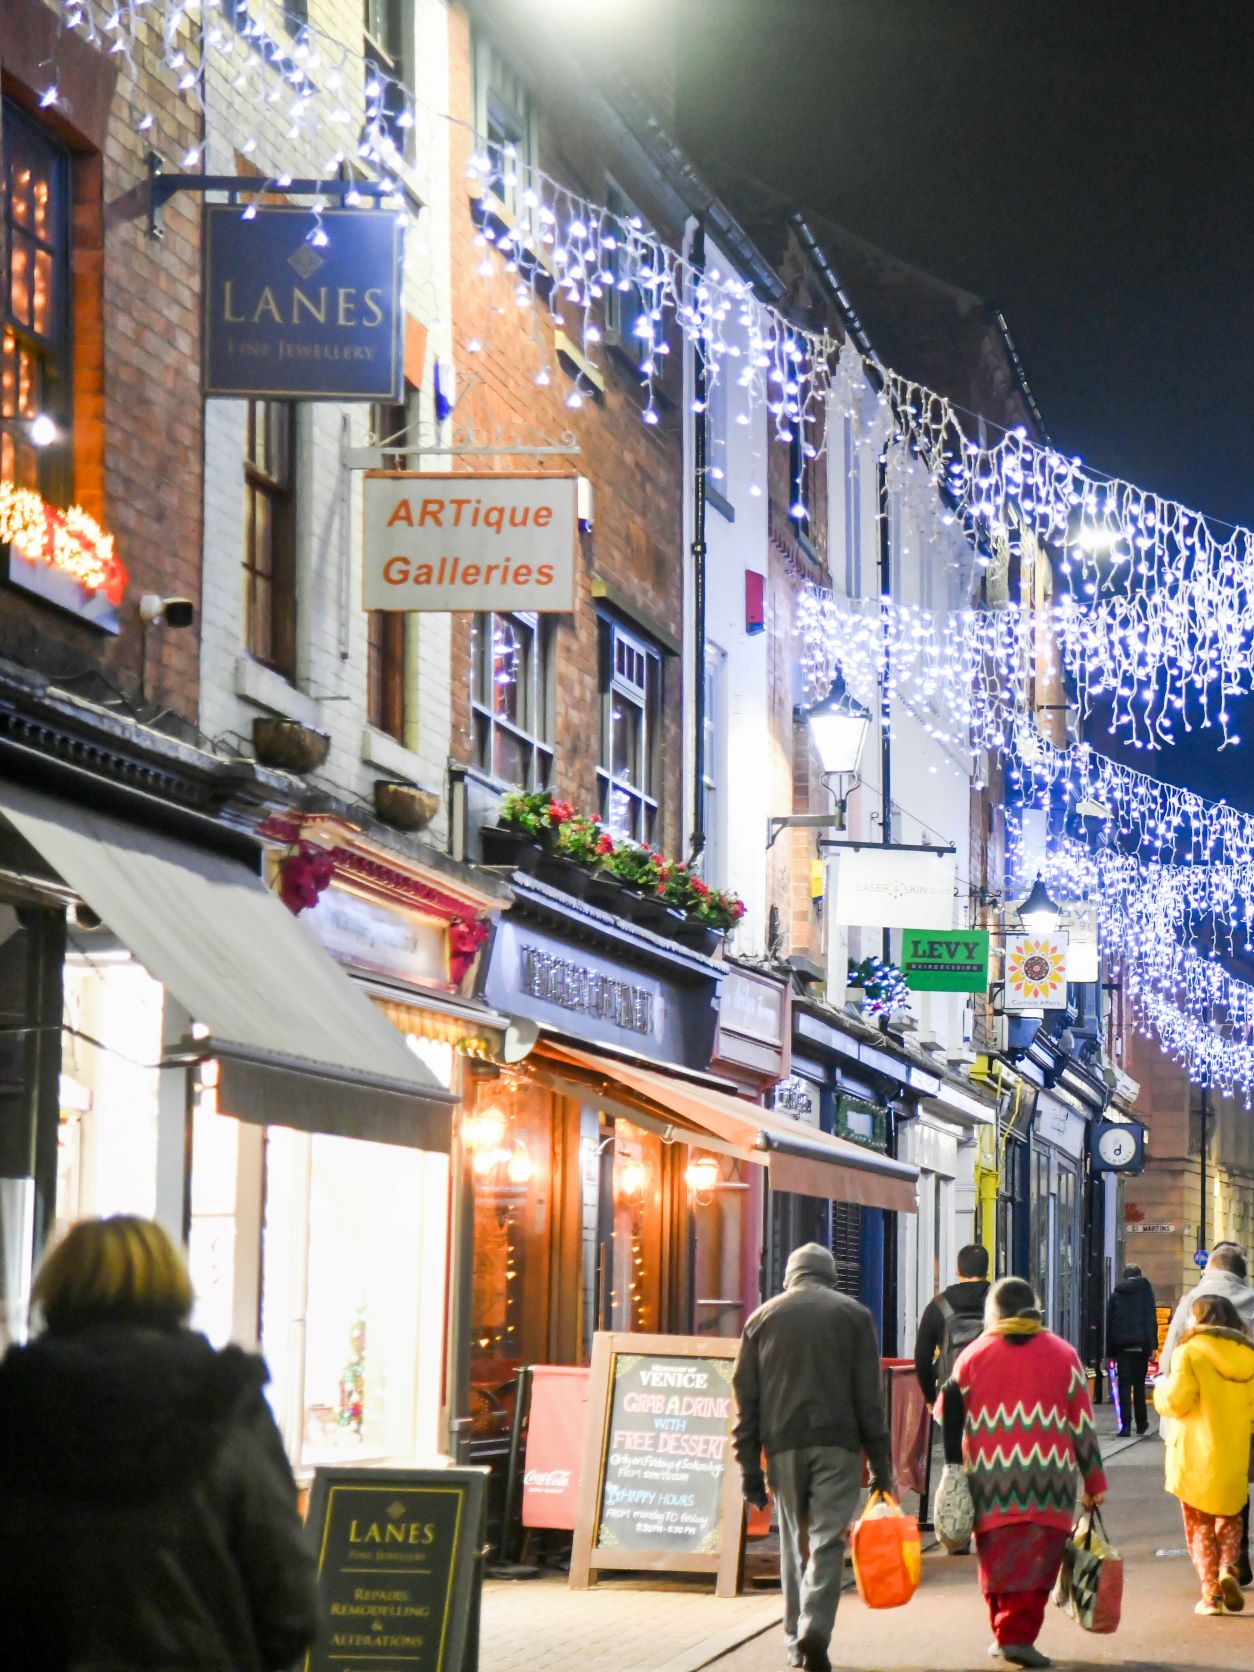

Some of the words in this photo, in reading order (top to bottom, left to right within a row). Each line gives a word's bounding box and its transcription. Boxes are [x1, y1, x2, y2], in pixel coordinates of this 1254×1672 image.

[223, 281, 383, 327] LANES
[278, 340, 376, 360] JEWELLERY
[386, 498, 553, 535] ARTique
[383, 556, 555, 586] Galleries
[911, 940, 980, 960] LEVY
[639, 1371, 709, 1389] VENICE
[623, 1391, 667, 1414] GRAB
[665, 1395, 681, 1416] A
[680, 1396, 731, 1418] DRINK
[654, 1418, 687, 1432] WITH
[612, 1430, 657, 1452] FREE
[656, 1432, 729, 1460] DESSERT
[620, 1487, 657, 1504] HAPPY
[658, 1494, 695, 1507] HOURS
[349, 1519, 436, 1545] LANES
